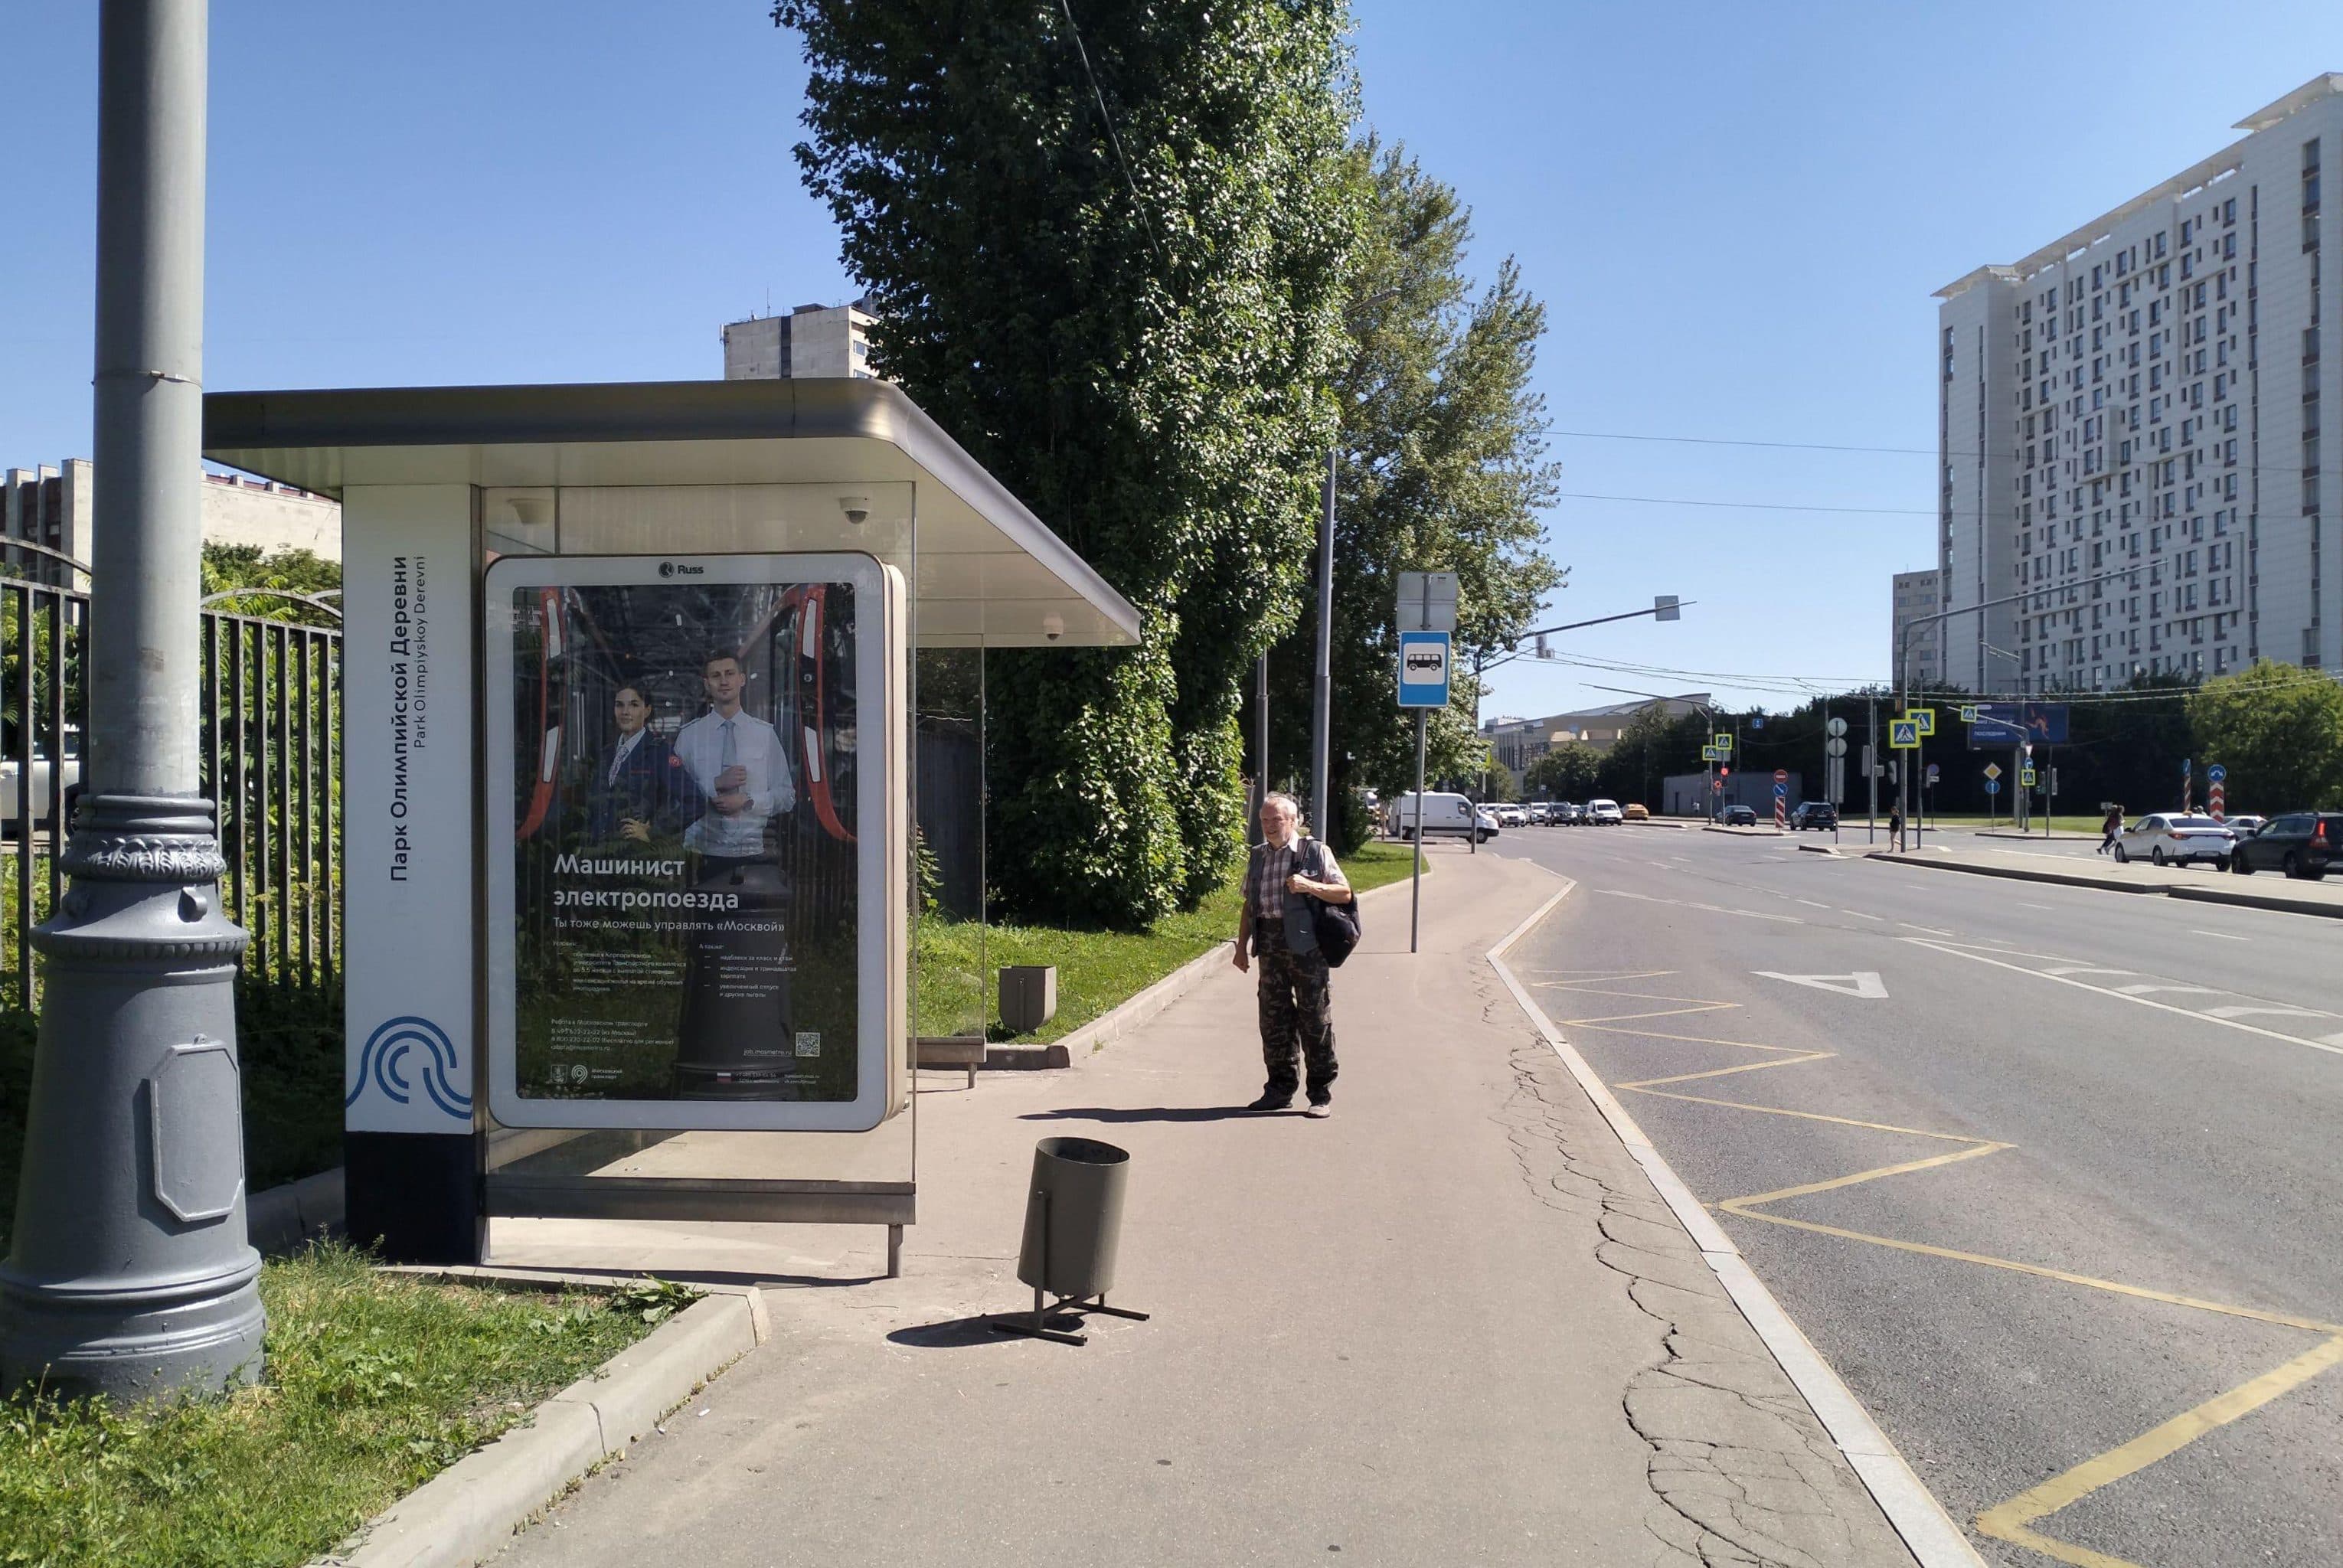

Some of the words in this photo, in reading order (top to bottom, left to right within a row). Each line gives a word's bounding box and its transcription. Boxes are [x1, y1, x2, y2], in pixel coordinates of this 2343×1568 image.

[413, 557, 426, 613] Derevni
[678, 564, 704, 574] Russ
[390, 557, 410, 655] Деревни
[413, 618, 428, 711] Olimpiyskoy
[390, 662, 407, 818] Олимпийской
[413, 714, 426, 748] Park
[390, 825, 410, 881] Парк
[554, 853, 685, 876] Машинист
[554, 890, 739, 912] электропоезда
[553, 917, 567, 928] Ты
[570, 920, 599, 929] тоже
[603, 920, 652, 929] можешь
[654, 921, 714, 932] управлять
[717, 920, 785, 932] «Москвой»
